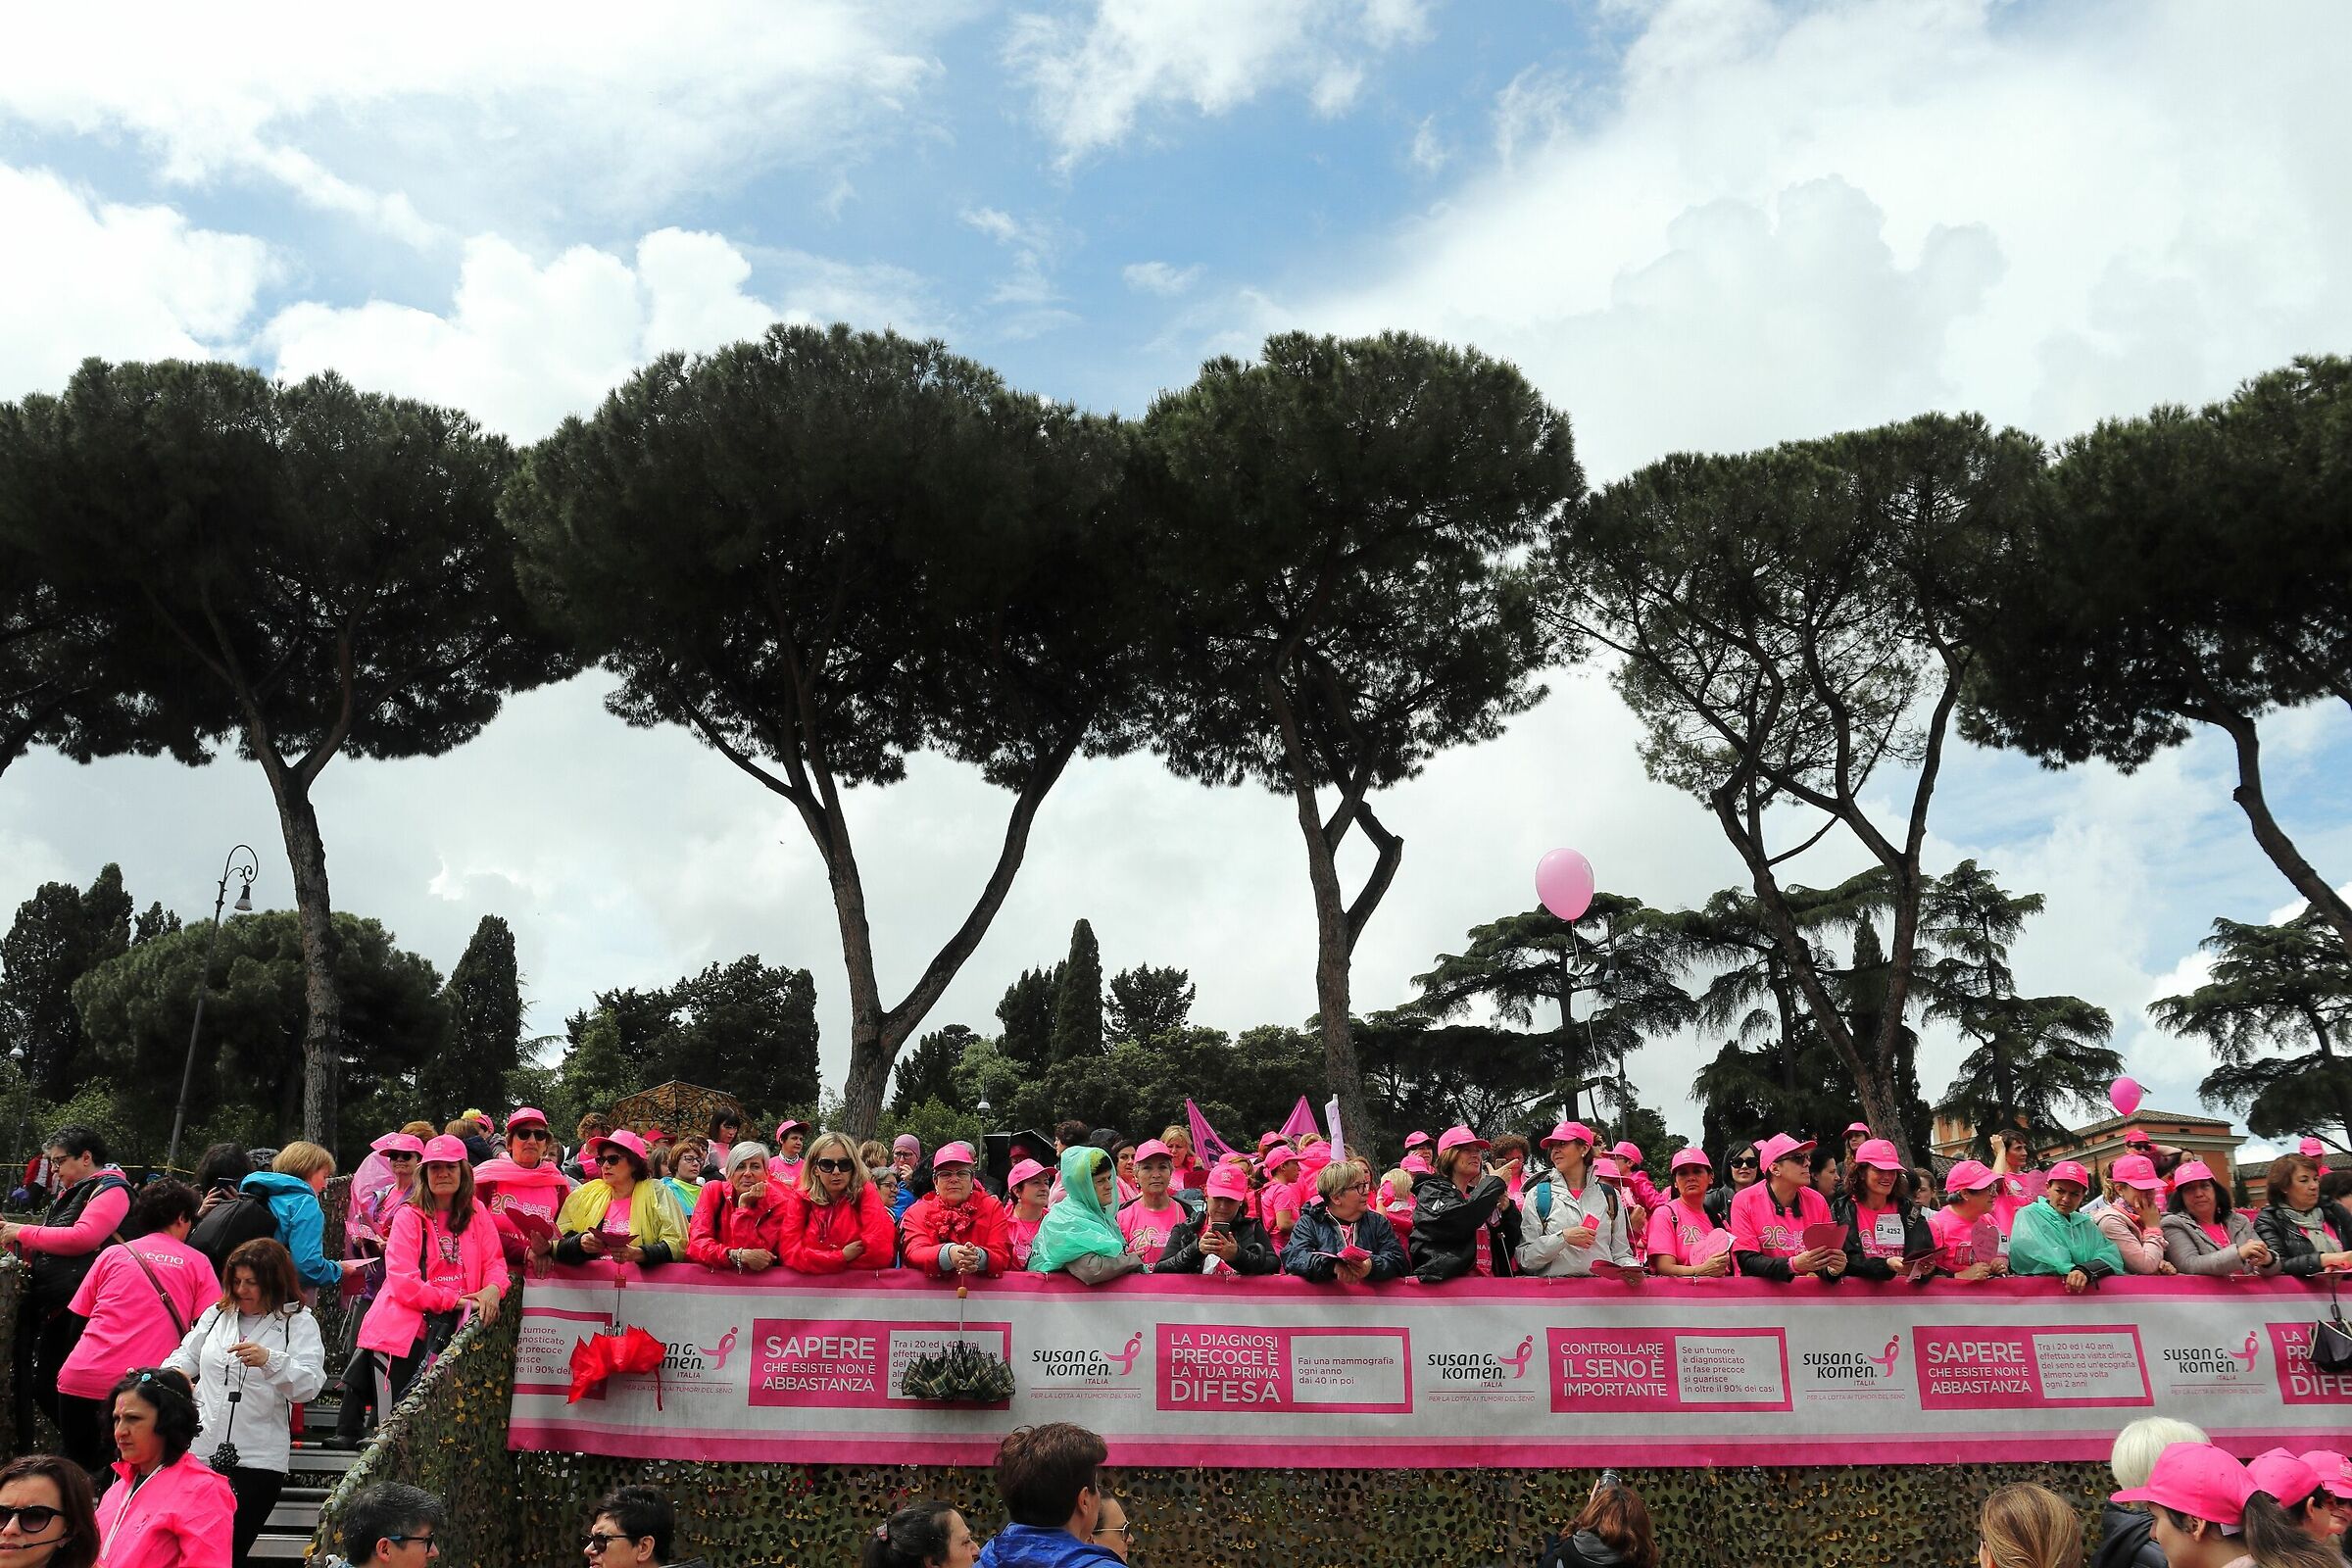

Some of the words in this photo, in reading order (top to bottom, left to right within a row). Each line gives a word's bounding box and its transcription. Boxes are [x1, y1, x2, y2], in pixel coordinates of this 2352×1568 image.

[517, 1336, 565, 1346] gnosticato
[1171, 1333, 1192, 1345] LA
[1200, 1333, 1278, 1348] DIAGNOSI
[2281, 1331, 2303, 1343] LA
[764, 1336, 876, 1359] SAPERE
[1560, 1343, 1664, 1354] CONTROLLARE
[1927, 1342, 2026, 1364] SAPERE
[2164, 1348, 2211, 1360] susan
[2215, 1348, 2228, 1360] G.
[1032, 1350, 1085, 1362] susan
[1090, 1350, 1102, 1362] G.
[1172, 1348, 1263, 1365] PRECOCE
[1268, 1347, 1280, 1366] È
[1333, 1356, 1394, 1366] mammografia
[1427, 1353, 1480, 1366] susan
[1484, 1353, 1495, 1366] G.
[1803, 1352, 1851, 1365] susan
[1855, 1352, 1867, 1364] G.
[763, 1362, 788, 1372] CHE
[792, 1362, 833, 1374] ESISTE
[837, 1364, 864, 1374] NON
[868, 1362, 876, 1374] È
[1563, 1359, 1582, 1378] IL
[1586, 1358, 1646, 1378] SENO
[1650, 1354, 1666, 1378] È
[1713, 1366, 1744, 1375] precoce
[1929, 1367, 1952, 1378] CHE
[1955, 1366, 1991, 1377] ESISTE
[1995, 1366, 2019, 1377] NON
[2023, 1364, 2030, 1376] È
[2088, 1361, 2135, 1370] un'ecografia
[2287, 1362, 2308, 1374] LA
[1171, 1366, 1192, 1378] LA
[1196, 1366, 1228, 1378] TUA
[1233, 1366, 1281, 1380] PRIMA
[762, 1376, 875, 1392] ABBASTANZA
[1341, 1377, 1354, 1386] poi
[1931, 1380, 2033, 1395] ABBASTANZA
[2046, 1381, 2063, 1390] ogni
[2290, 1375, 2352, 1396] DIFE
[1170, 1380, 1282, 1403] DIFESA
[1564, 1382, 1668, 1396] IMPORTANTE
